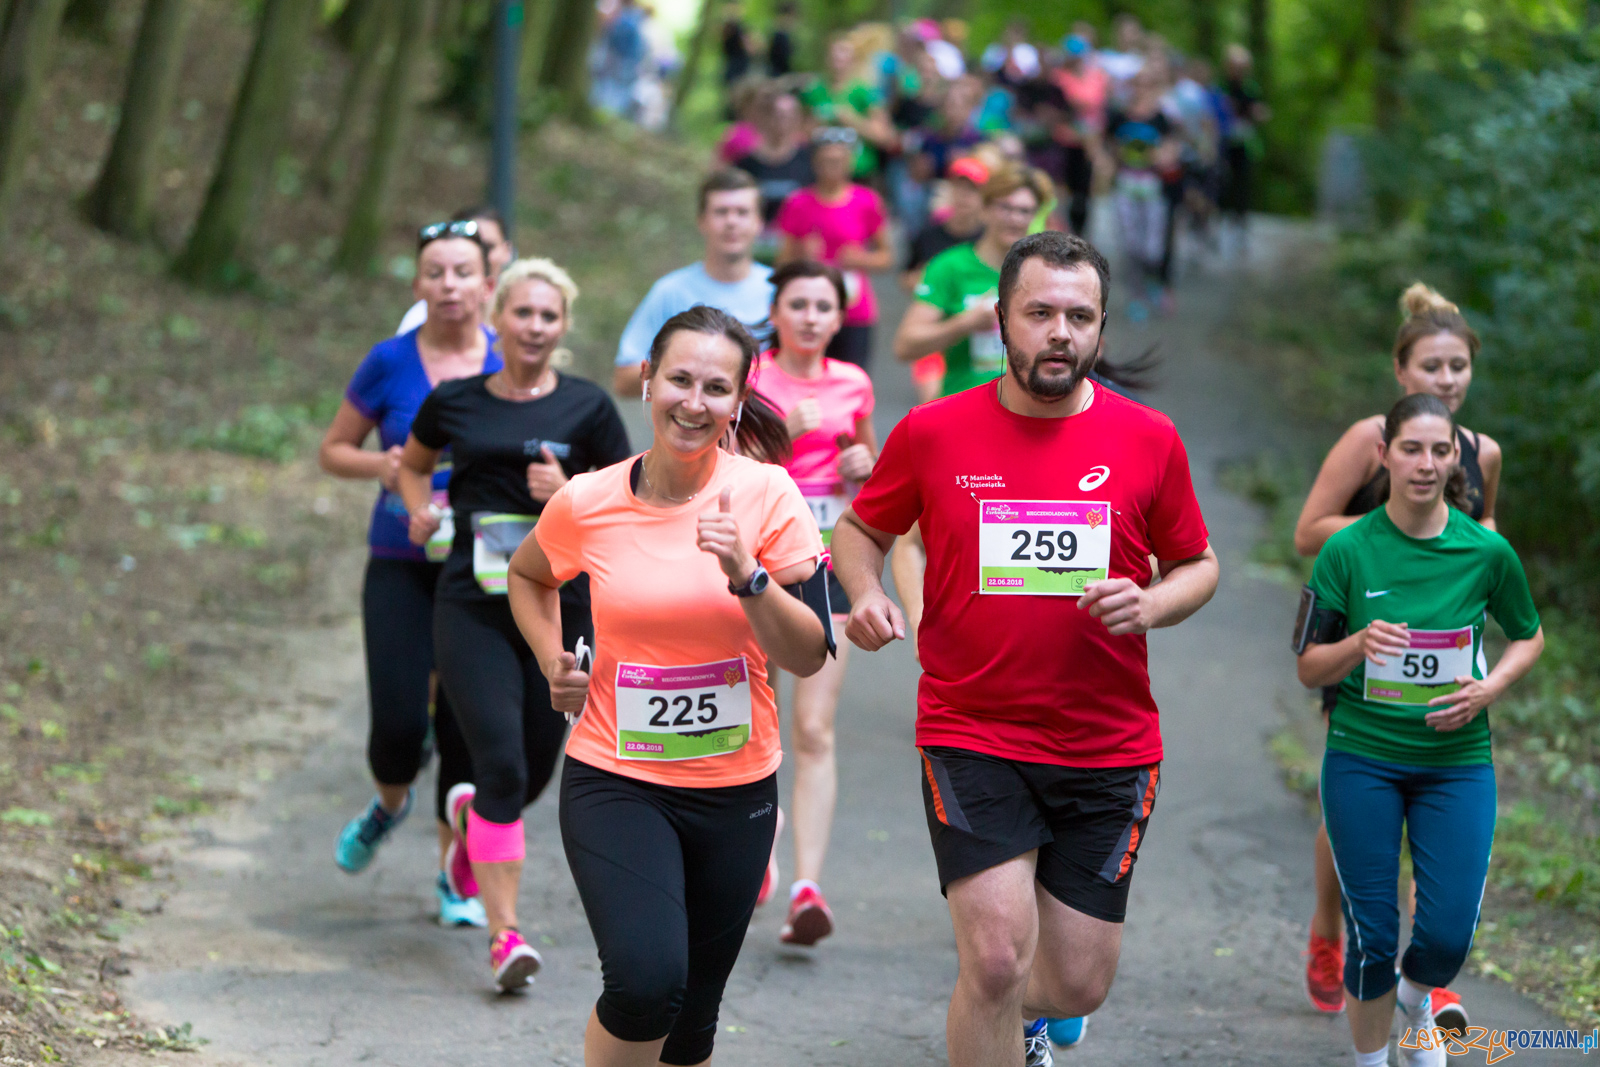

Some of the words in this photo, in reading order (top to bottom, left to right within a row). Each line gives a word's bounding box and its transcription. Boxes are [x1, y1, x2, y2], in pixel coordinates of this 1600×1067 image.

[955, 475, 969, 489] 13
[1010, 529, 1078, 562] 259
[988, 578, 1023, 586] 22.06.2018
[1402, 652, 1439, 679] 59
[648, 692, 718, 727] 225
[626, 742, 663, 752] 22.06.2018
